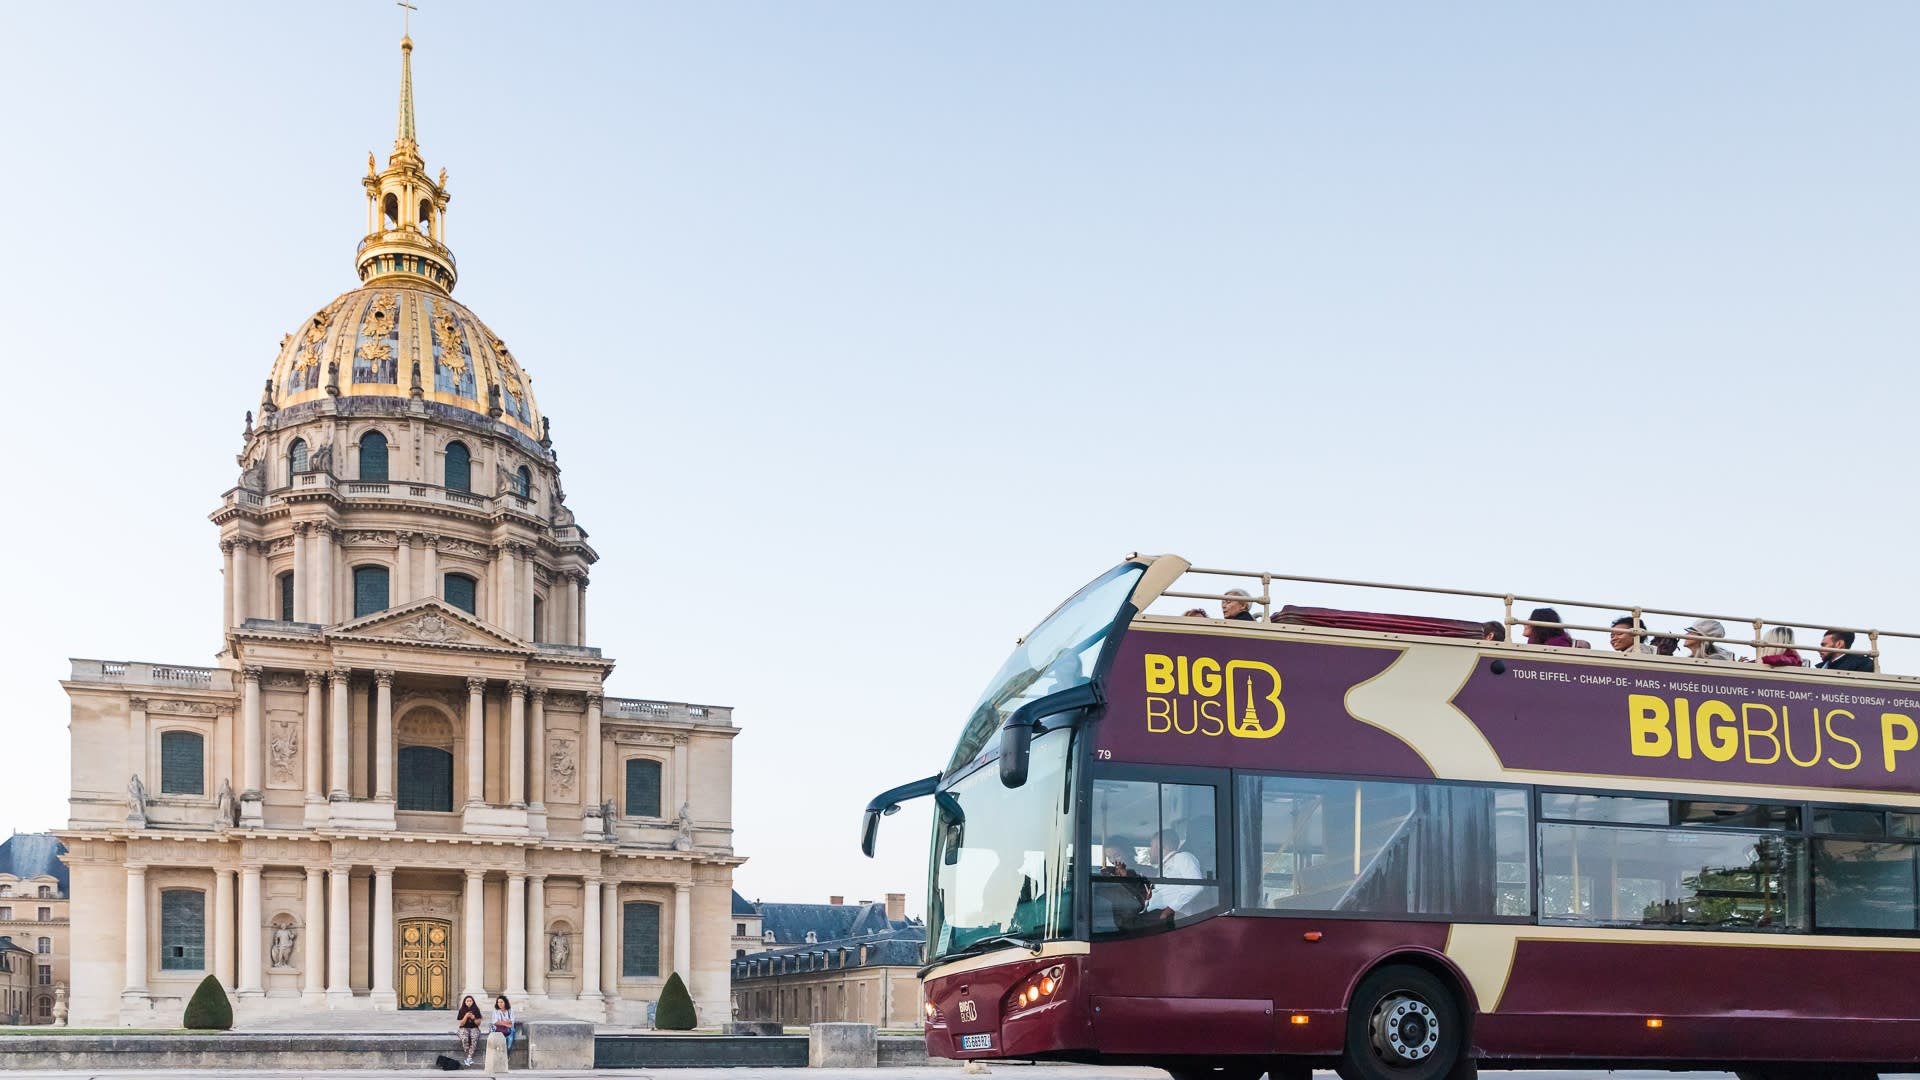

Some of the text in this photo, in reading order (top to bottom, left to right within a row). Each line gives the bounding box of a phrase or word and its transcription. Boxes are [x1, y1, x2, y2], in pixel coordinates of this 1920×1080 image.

[1145, 653, 1222, 697] BIG
[1513, 669, 1537, 680] TOUR
[1540, 671, 1570, 683] EIFFEL
[1636, 679, 1660, 689] MARS
[1669, 681, 1699, 693] MUSÉE
[1702, 684, 1714, 694] DU
[1716, 685, 1749, 696] LOUVRE
[1821, 692, 1850, 704] MUSÉE
[1852, 695, 1886, 706] D'ORSAY
[1146, 696, 1224, 736] BUS
[1097, 749, 1111, 760] 79
[1881, 712, 1919, 772] P
